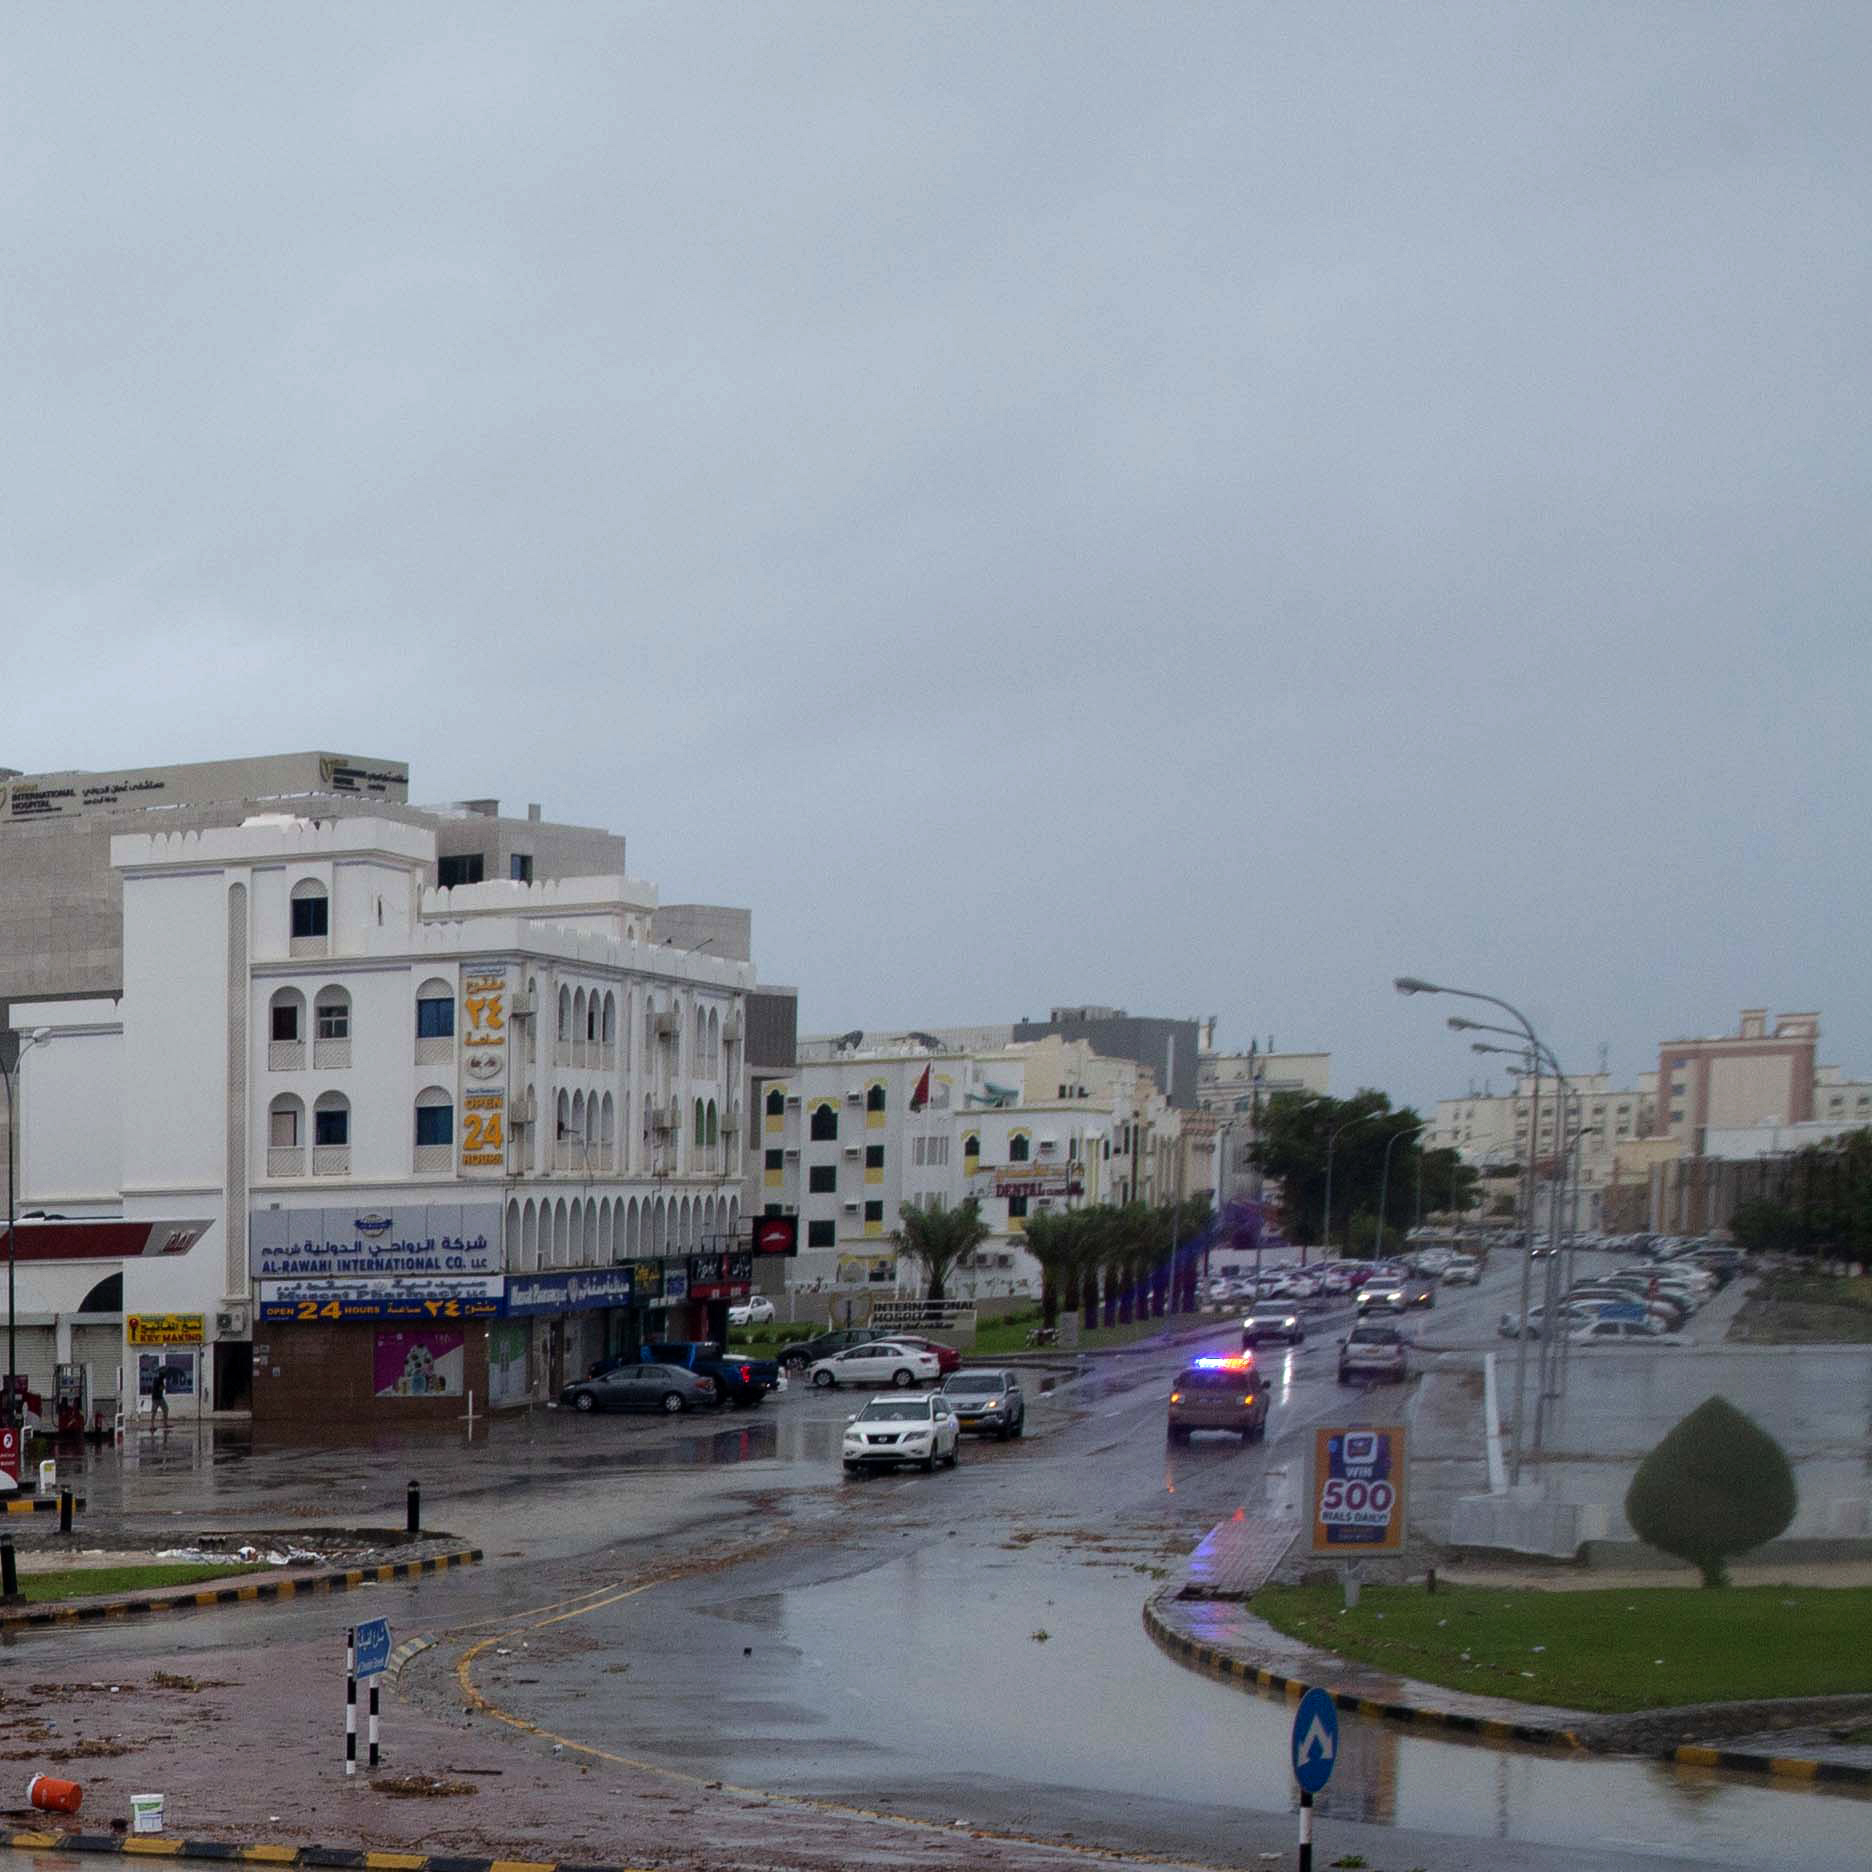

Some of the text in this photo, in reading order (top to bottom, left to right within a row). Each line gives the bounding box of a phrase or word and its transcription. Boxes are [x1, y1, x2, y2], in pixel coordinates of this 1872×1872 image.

[465, 995, 504, 1030] ٢٤
[464, 1097, 503, 1110] OPEN
[463, 1113, 504, 1151] 24
[304, 1240, 362, 1256] الدولية
[368, 1239, 435, 1257] الرواحي
[442, 1235, 487, 1251] شركة
[263, 1260, 332, 1273] AL-RAWAHI
[337, 1256, 441, 1272] INTERNATIONAL
[446, 1256, 466, 1269] CO.
[266, 1299, 380, 1320] OPEN 24 HOURS
[424, 1297, 461, 1318] ٢٤
[874, 1302, 975, 1311] INTERNONAL
[1345, 1465, 1374, 1478] WIN
[1323, 1481, 1393, 1511] 500
